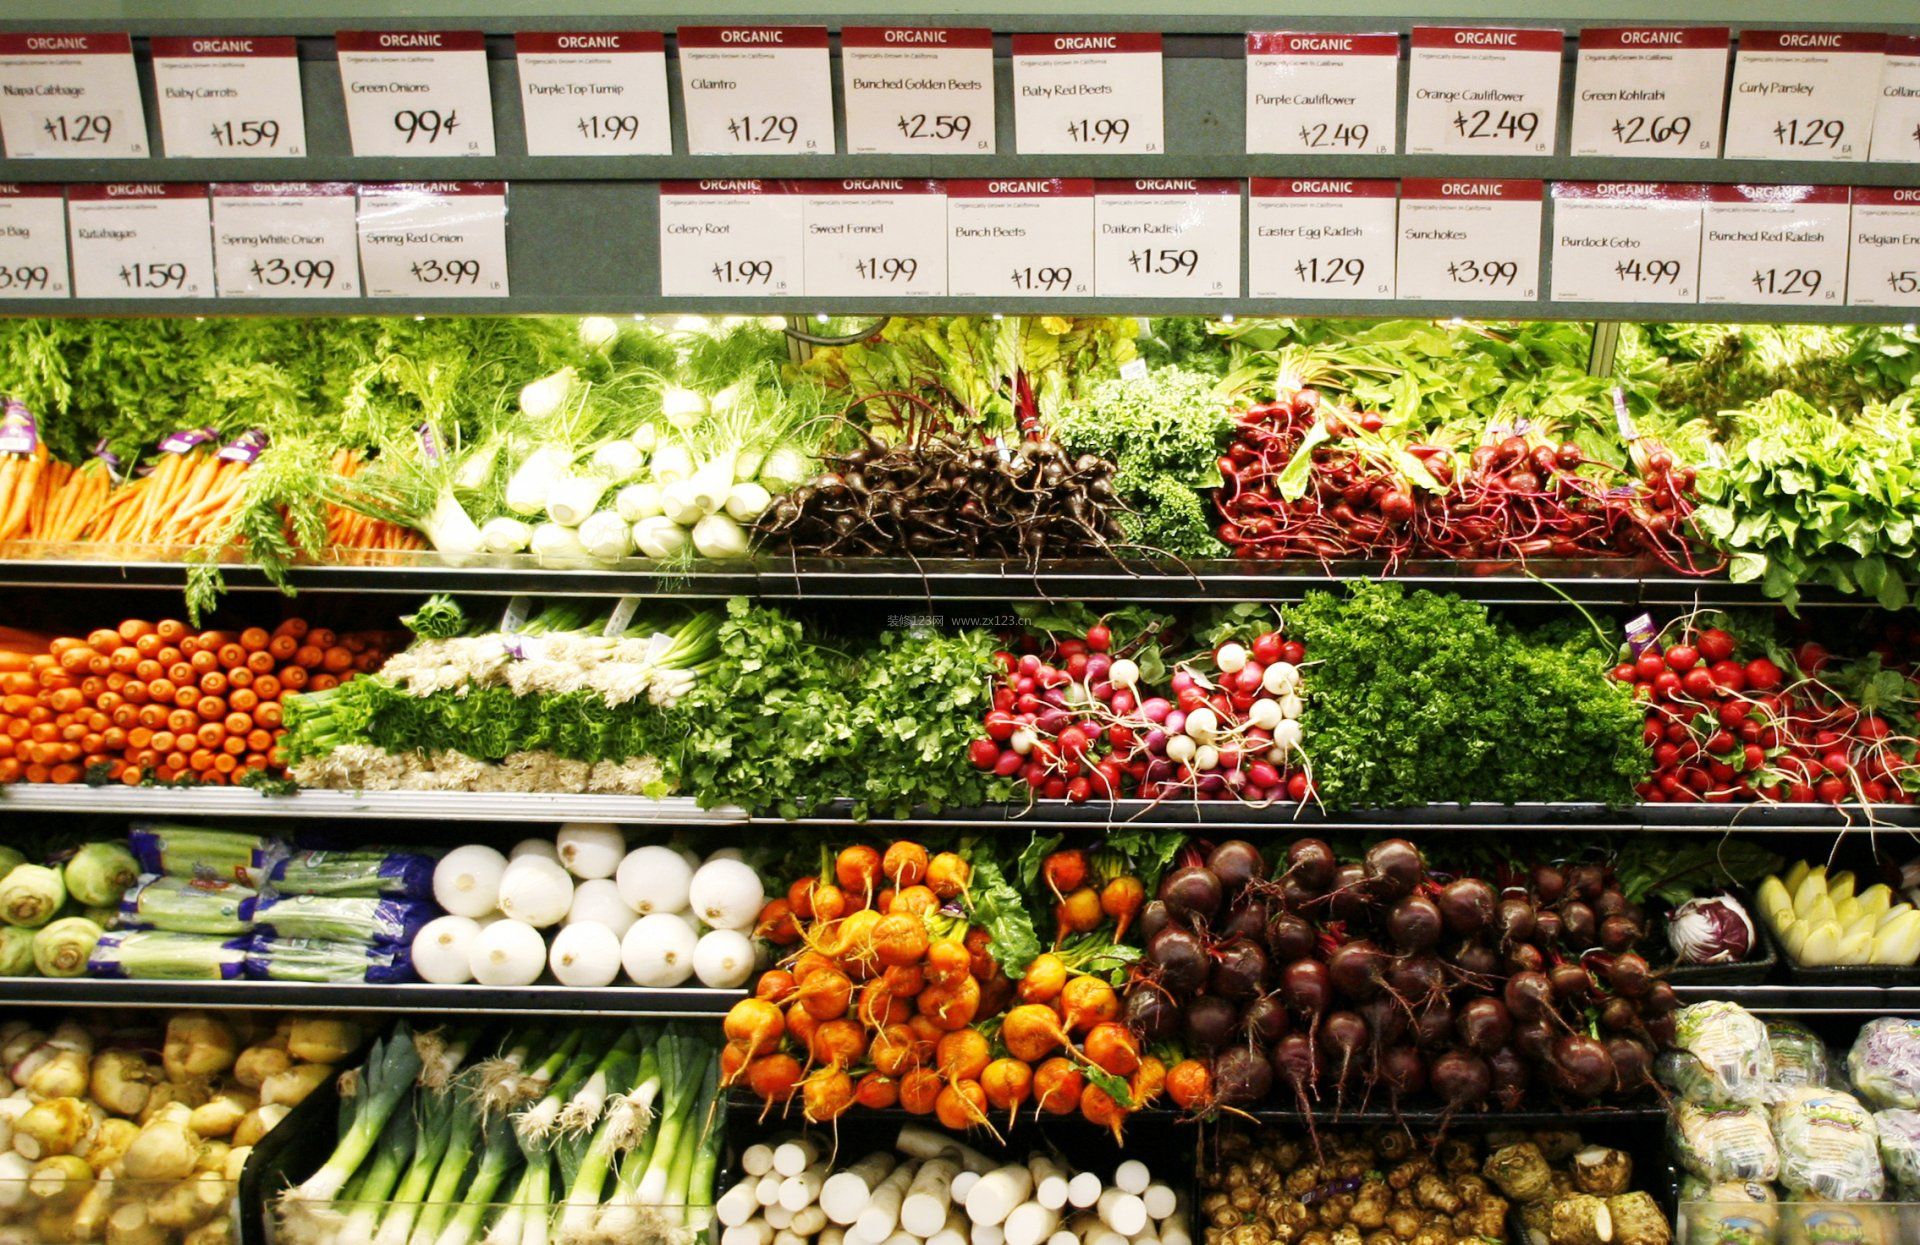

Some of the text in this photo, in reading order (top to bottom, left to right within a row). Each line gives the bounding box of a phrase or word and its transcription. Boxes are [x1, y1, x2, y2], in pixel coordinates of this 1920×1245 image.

[380, 35, 442, 46] ORGANIC
[558, 36, 620, 48] ORGANIC
[722, 31, 783, 43] ORGANIC
[885, 31, 947, 42] ORGANIC
[1455, 33, 1517, 45] ORGANIC
[1621, 32, 1682, 44] ORGANIC
[1780, 35, 1842, 47] ORGANIC
[27, 38, 88, 50] ORGANIC
[193, 41, 253, 53] ORGANIC
[1055, 37, 1116, 50] ORGANIC
[1290, 39, 1352, 50] ORGANIC
[351, 83, 430, 93] Green Onions
[529, 84, 624, 96] Purple Top Turnip
[691, 79, 736, 89] Cilantro
[854, 79, 982, 90] Bunched Golden Beets
[1739, 83, 1814, 97] Curly Parsley
[4, 85, 84, 97] Napa Cabbage
[166, 87, 238, 100] Baby Carrots
[1022, 85, 1112, 98] Baby Red Beets
[1416, 90, 1524, 102] Orange Cauliflower
[1582, 90, 1665, 101] Green Kohlrabi
[1256, 95, 1355, 105] Purple Cauliflower
[44, 116, 111, 143] $1.29
[394, 110, 460, 143] 99¢
[578, 116, 638, 141] $1.99
[727, 116, 798, 144] $1.29
[898, 115, 971, 141] $2.59
[1067, 119, 1129, 144] $1.99
[1453, 110, 1538, 143] $2.49
[1612, 116, 1691, 145] $2.69
[211, 120, 279, 147] $1.59
[1299, 124, 1368, 149] $2.49
[1774, 119, 1844, 149] $1.29
[107, 185, 165, 196] ORGANIC
[700, 179, 761, 190] ORGANIC
[843, 179, 903, 190] ORGANIC
[989, 182, 1049, 193] ORGANIC
[1135, 179, 1196, 190] ORGANIC
[1292, 182, 1352, 193] ORGANIC
[1442, 184, 1502, 195] ORGANIC
[1597, 184, 1658, 195] ORGANIC
[7, 228, 29, 239] Bag
[667, 224, 729, 235] Celery Root
[809, 224, 884, 234] Sweet Fennel
[956, 227, 1026, 237] Bunch Beets
[1103, 223, 1141, 234] Daikon
[1259, 227, 1362, 239] Easter Egg Radish
[222, 234, 324, 246] Spring White Onion
[367, 233, 463, 245] Spring Red Onion
[1405, 230, 1467, 240] Sunchokes
[1710, 232, 1824, 242] Bunched Red Radish
[1859, 234, 1899, 247] Belgian
[1562, 237, 1640, 248] Burdock Gobo
[1129, 249, 1198, 275] $1.59
[119, 263, 186, 289] $1.59
[251, 258, 335, 288] $3.99
[411, 260, 480, 284] $3.99
[712, 260, 772, 285] $1.99
[855, 258, 917, 282] $1.99
[1295, 258, 1364, 286] $1.29
[1447, 260, 1517, 286] $3.99
[1615, 259, 1680, 285] $4.99
[1011, 267, 1072, 292] $1.99
[1752, 269, 1821, 296] $1.29
